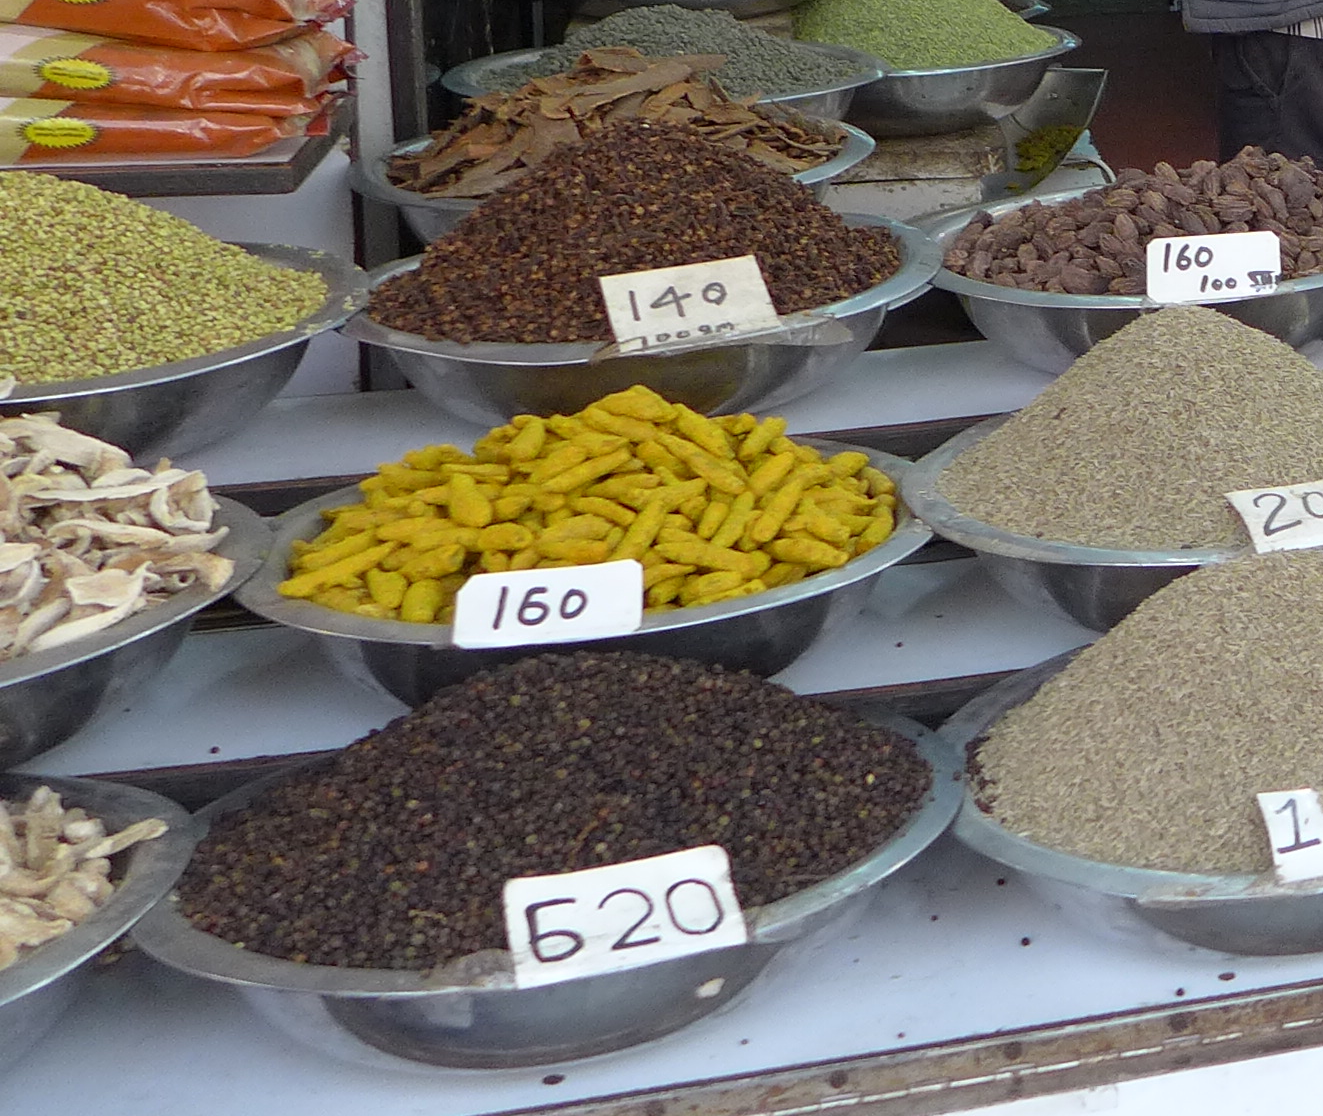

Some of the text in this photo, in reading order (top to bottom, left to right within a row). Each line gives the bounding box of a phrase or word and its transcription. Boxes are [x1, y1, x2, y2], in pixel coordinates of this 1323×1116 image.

[1163, 242, 1214, 273] 160
[628, 281, 729, 322] 140
[1199, 274, 1237, 293] 100
[492, 586, 588, 631] 160
[525, 879, 725, 964] 620
